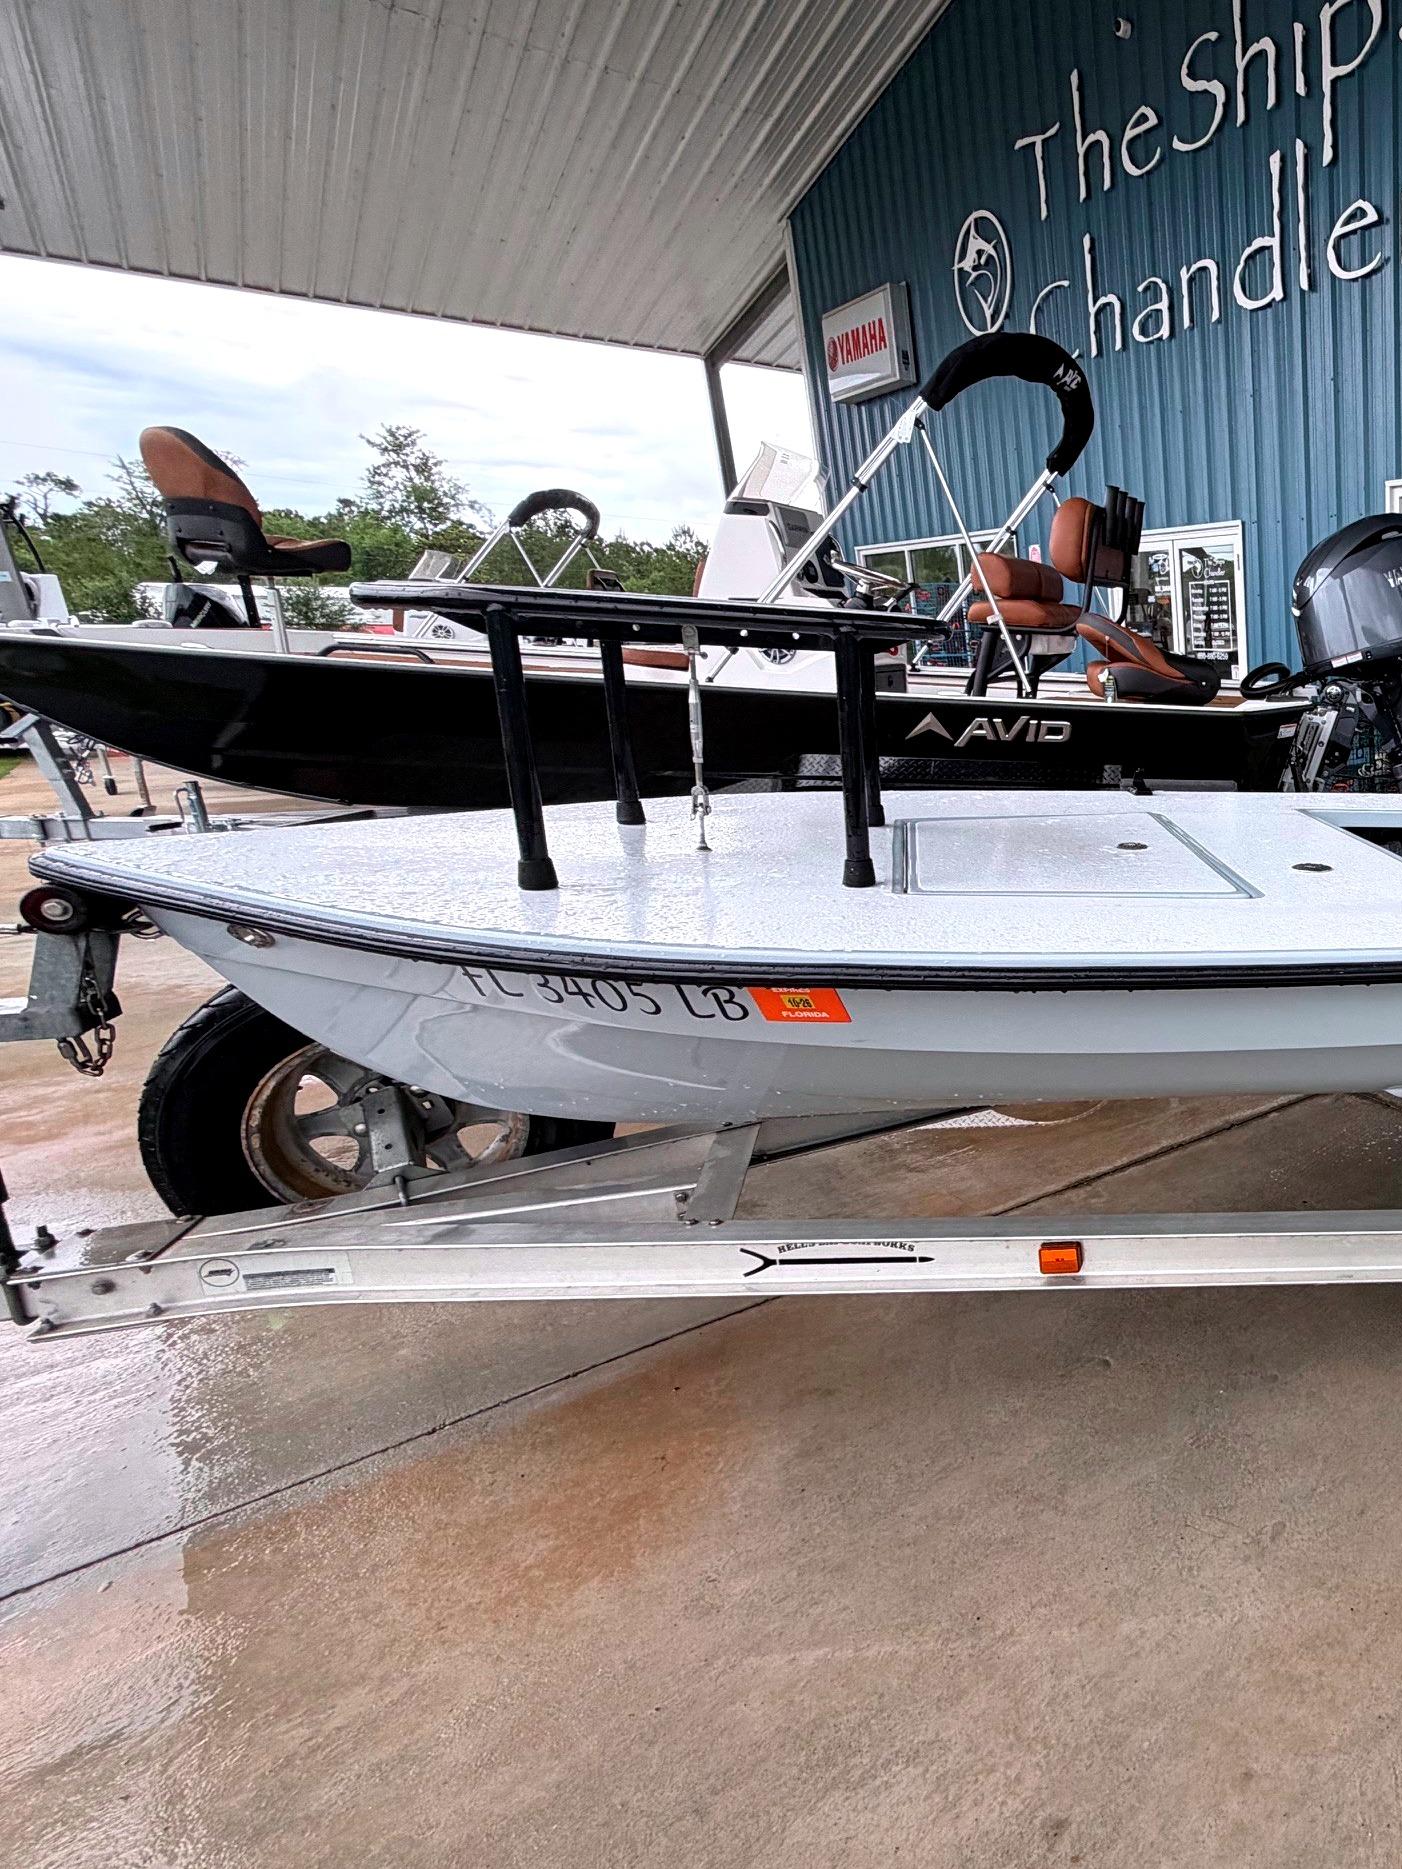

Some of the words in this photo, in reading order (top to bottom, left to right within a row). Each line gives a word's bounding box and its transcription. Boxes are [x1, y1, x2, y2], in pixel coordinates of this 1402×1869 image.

[1014, 68, 1161, 221] The
[837, 318, 887, 365] YAMAHA
[954, 715, 1072, 747] AVID
[536, 974, 662, 1016] 3405
[675, 984, 750, 1022] LB
[781, 1010, 829, 1019] FLORIDA
